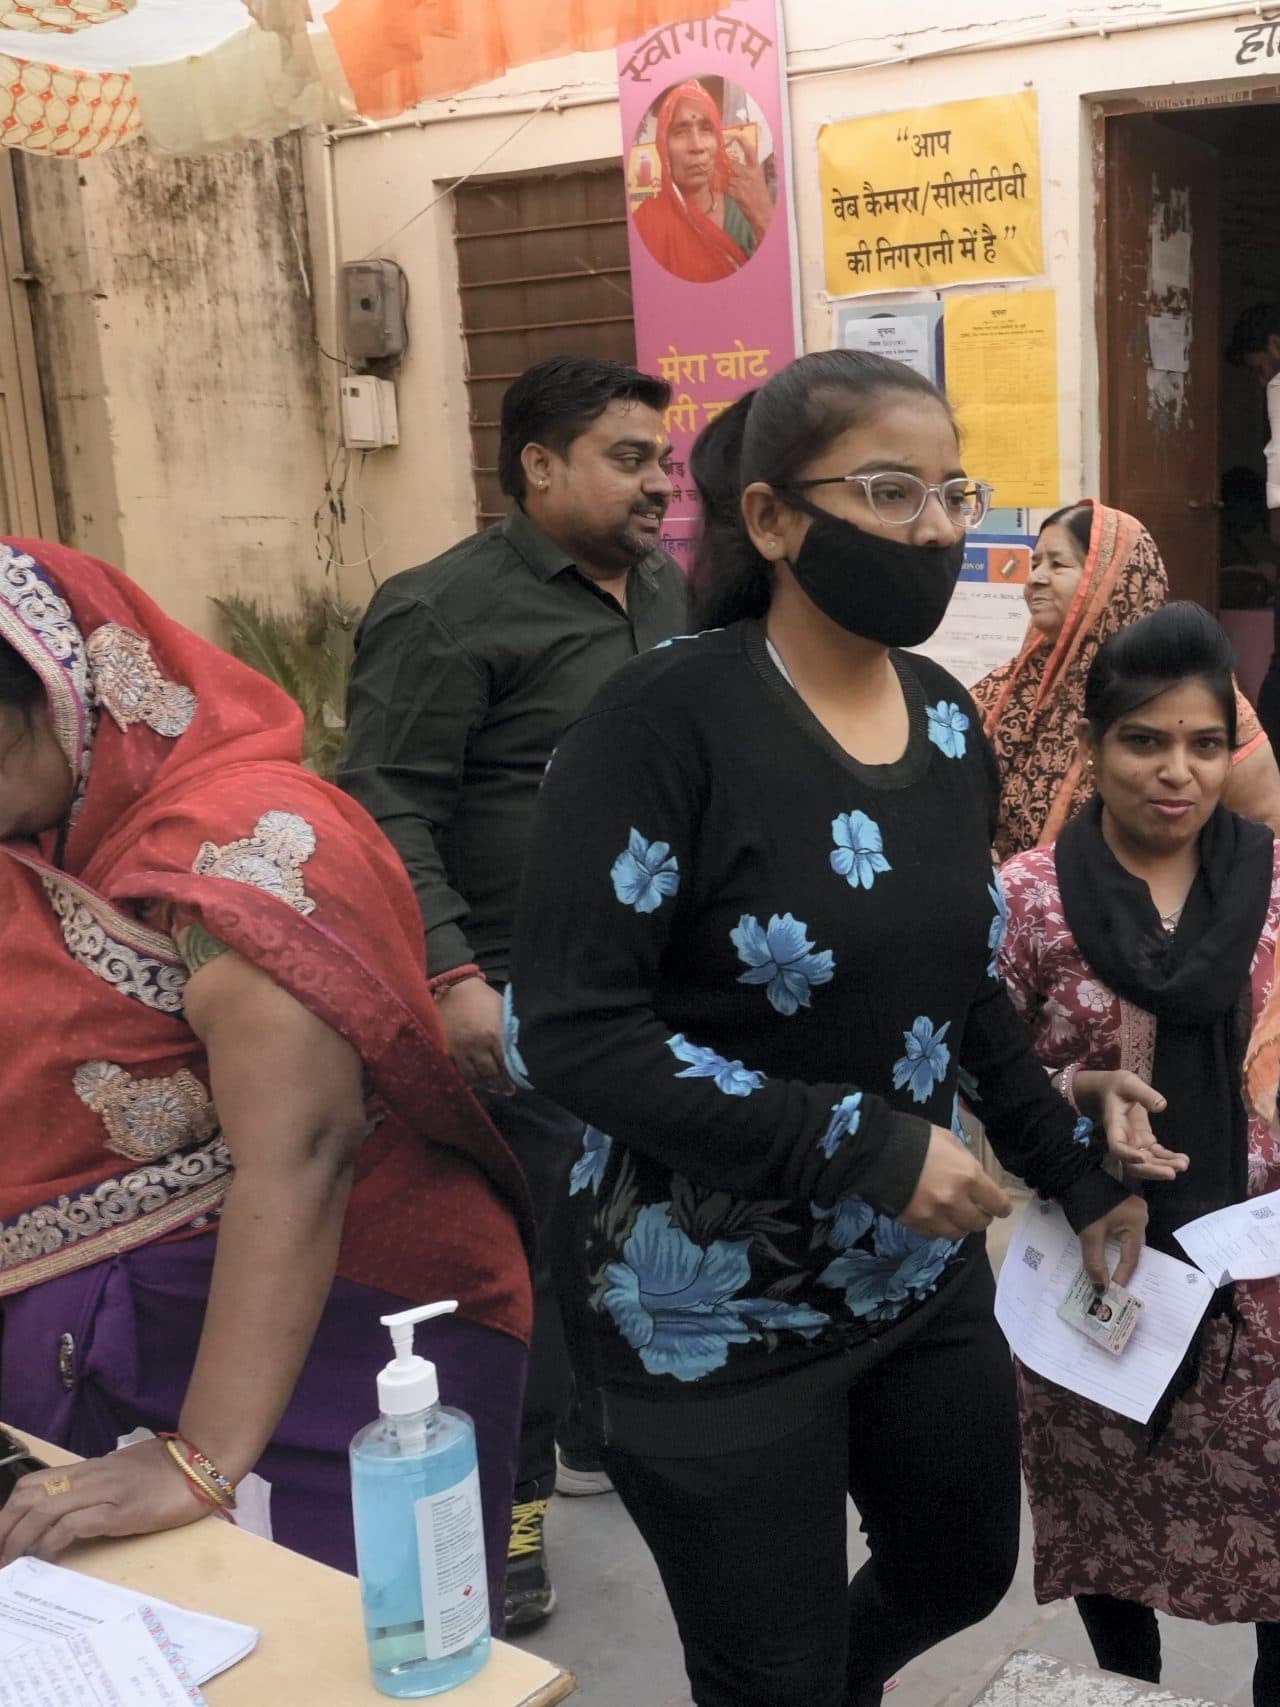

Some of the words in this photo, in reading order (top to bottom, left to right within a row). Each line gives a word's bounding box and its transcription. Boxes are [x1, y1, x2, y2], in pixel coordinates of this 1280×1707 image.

[619, 14, 774, 83] स्वागतम
[832, 188, 860, 221] वेब
[846, 239, 872, 276] की
[875, 229, 954, 273] निगरानी
[958, 228, 978, 263] में
[656, 345, 709, 385] मेरा
[712, 338, 771, 381] वोट
